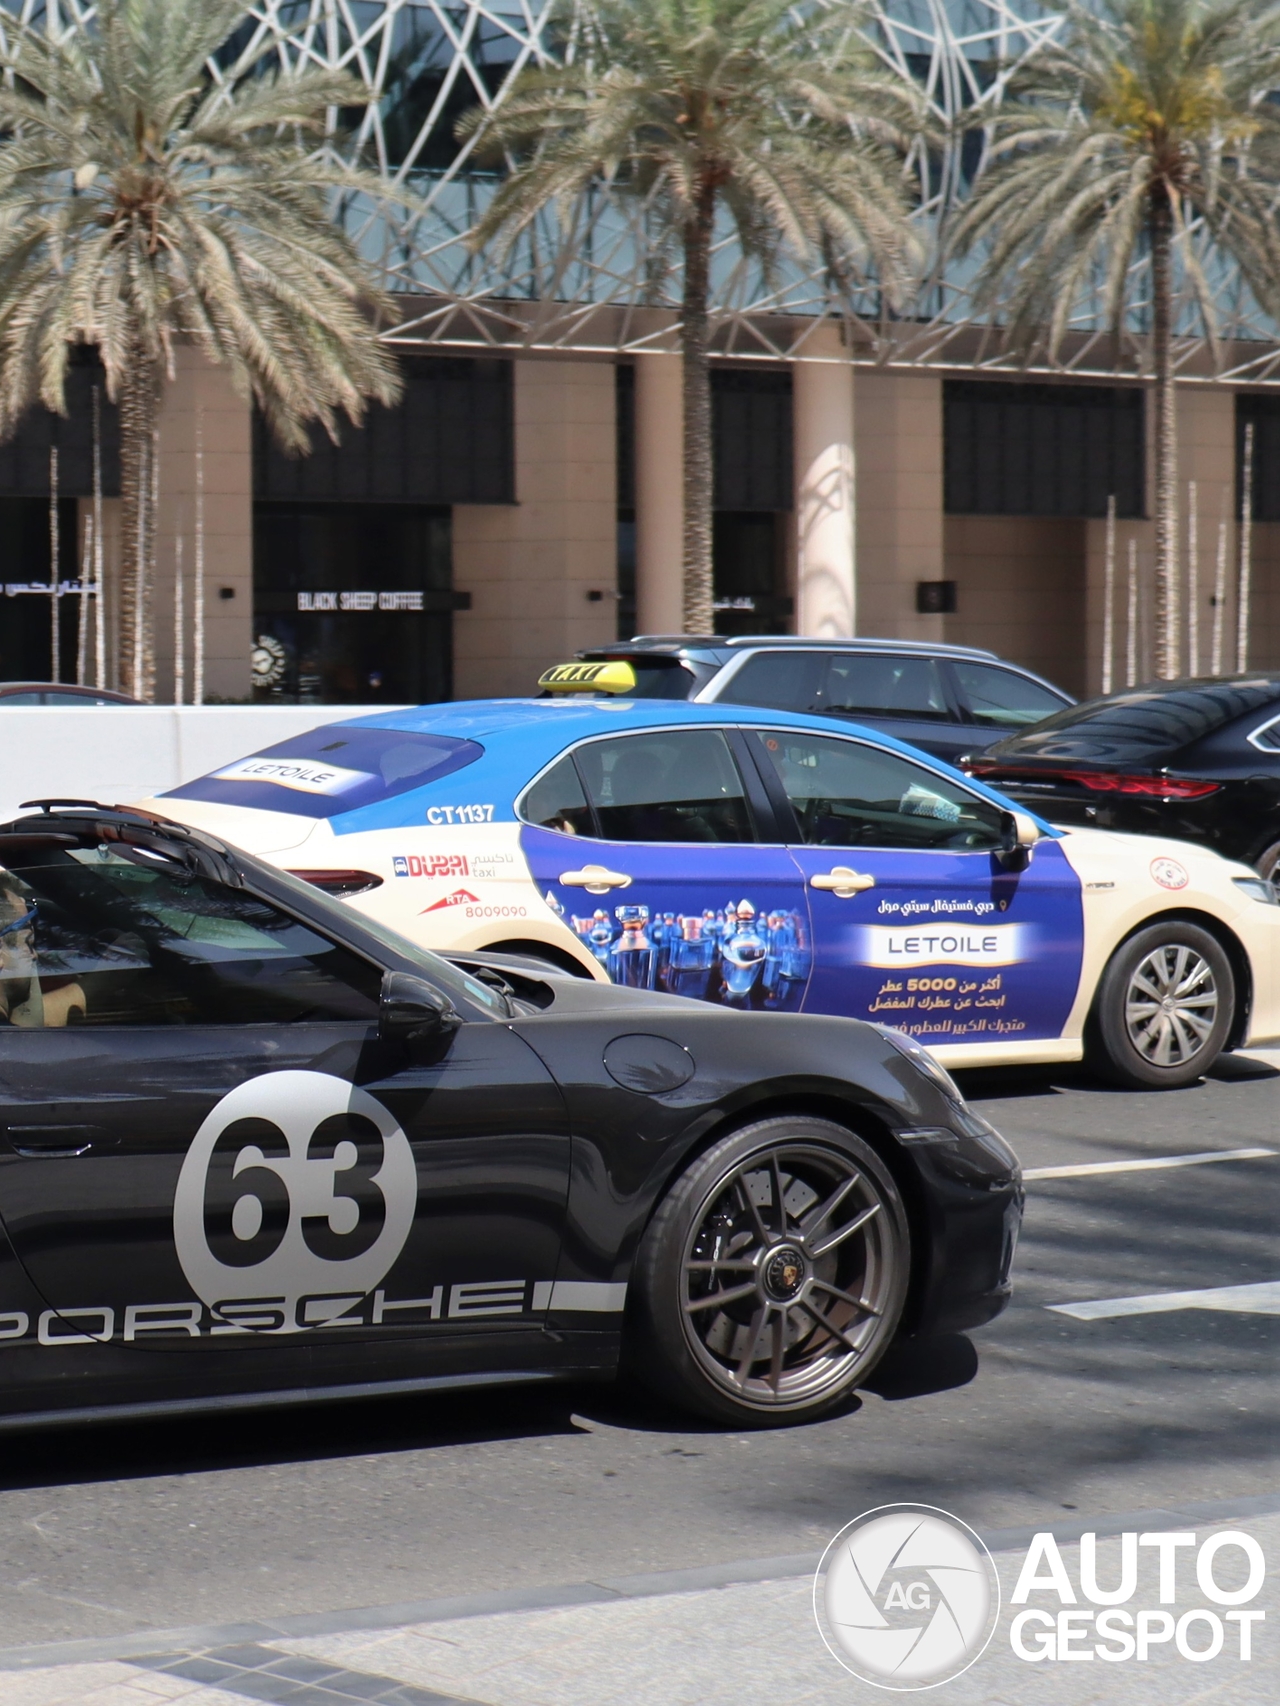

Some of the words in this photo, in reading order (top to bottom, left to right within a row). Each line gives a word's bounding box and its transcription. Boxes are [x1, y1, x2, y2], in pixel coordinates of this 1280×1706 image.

[297, 592, 338, 611] BLACK
[339, 592, 377, 611] SHEEP
[378, 592, 424, 611] COFFEE
[549, 665, 600, 681] TAXI
[240, 763, 335, 784] LETOILE
[426, 804, 494, 825] CT1137
[472, 866, 496, 878] taxi
[445, 894, 471, 905] RTA
[465, 906, 527, 918] 8009090
[877, 900, 899, 914] مول
[974, 902, 994, 915] دبي
[888, 936, 998, 953] LETOILE
[878, 980, 903, 994] عطر
[906, 978, 957, 992] 5000
[958, 981, 977, 993] من
[979, 975, 1001, 993] أكثر
[868, 997, 915, 1012] المفضل
[917, 996, 951, 1010] عطرك
[953, 999, 972, 1010] عن
[974, 995, 1005, 1009] ابحث
[203, 1112, 387, 1268] 63
